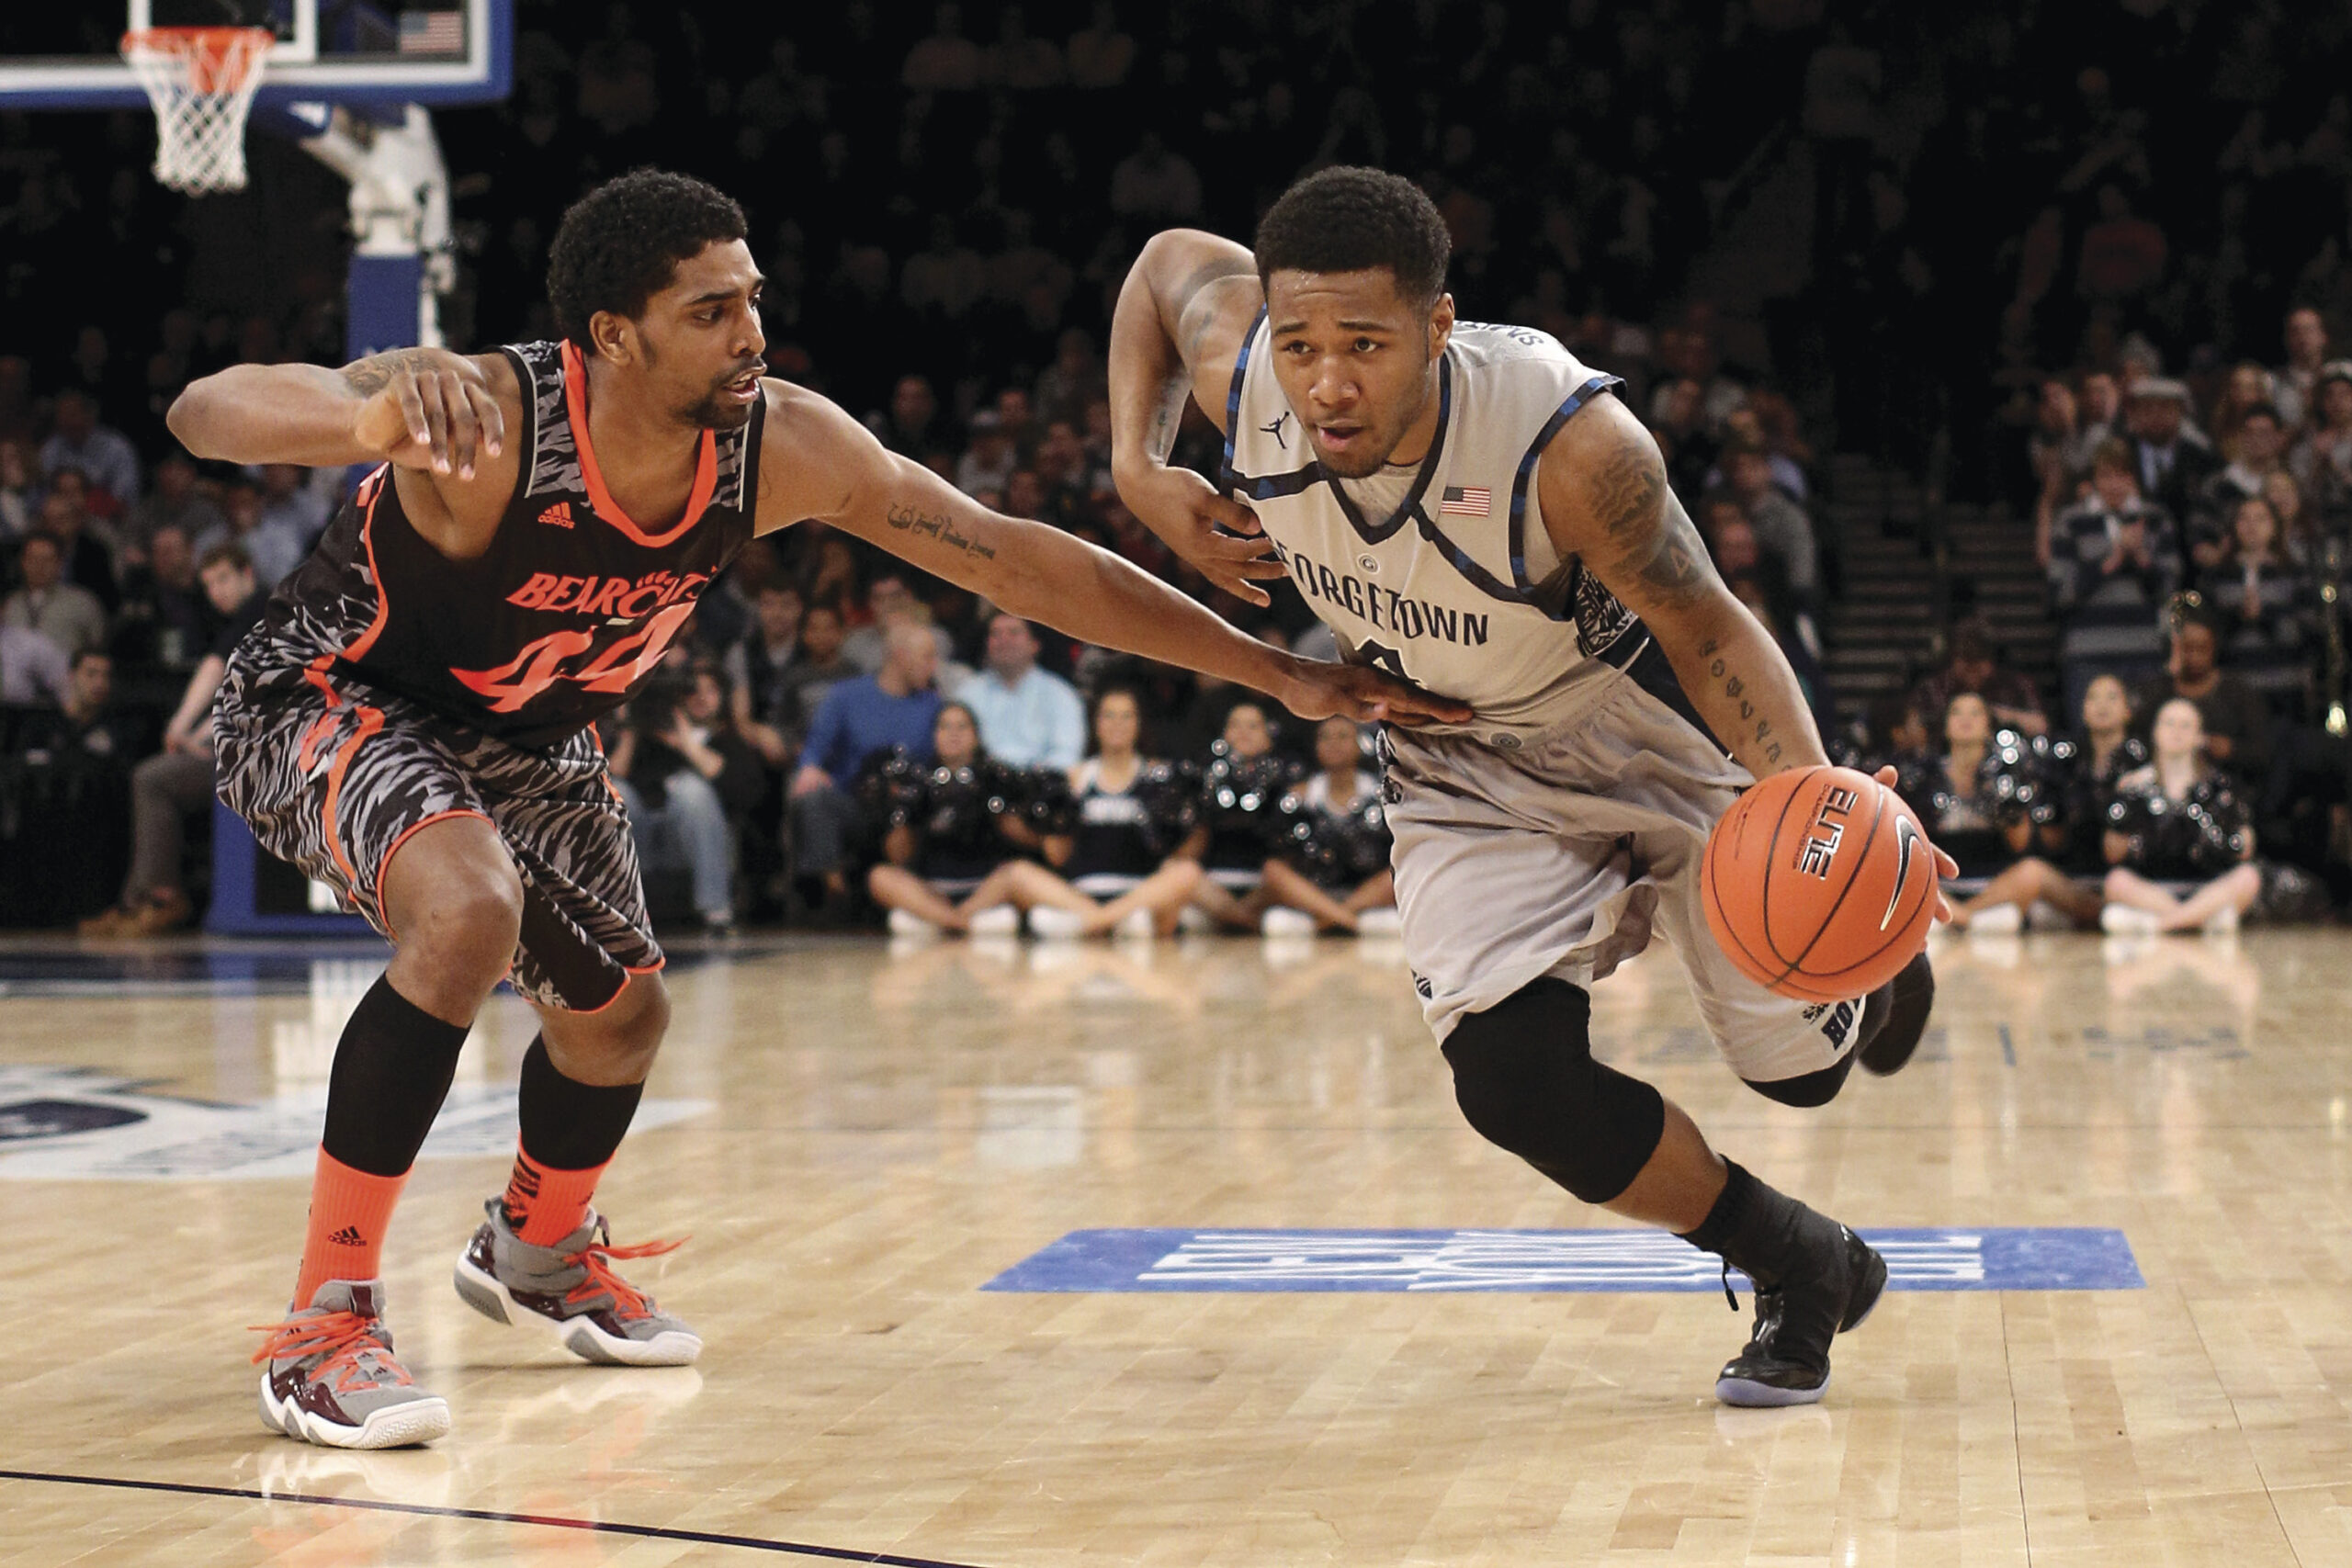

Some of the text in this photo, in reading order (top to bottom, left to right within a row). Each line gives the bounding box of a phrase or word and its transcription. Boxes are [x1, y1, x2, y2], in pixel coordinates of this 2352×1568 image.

[537, 513, 576, 530] adidas
[448, 600, 696, 714] 44
[1798, 785, 1859, 881] ELITE
[327, 1234, 368, 1247] adidas
[1138, 1235, 1436, 1280] NEW
